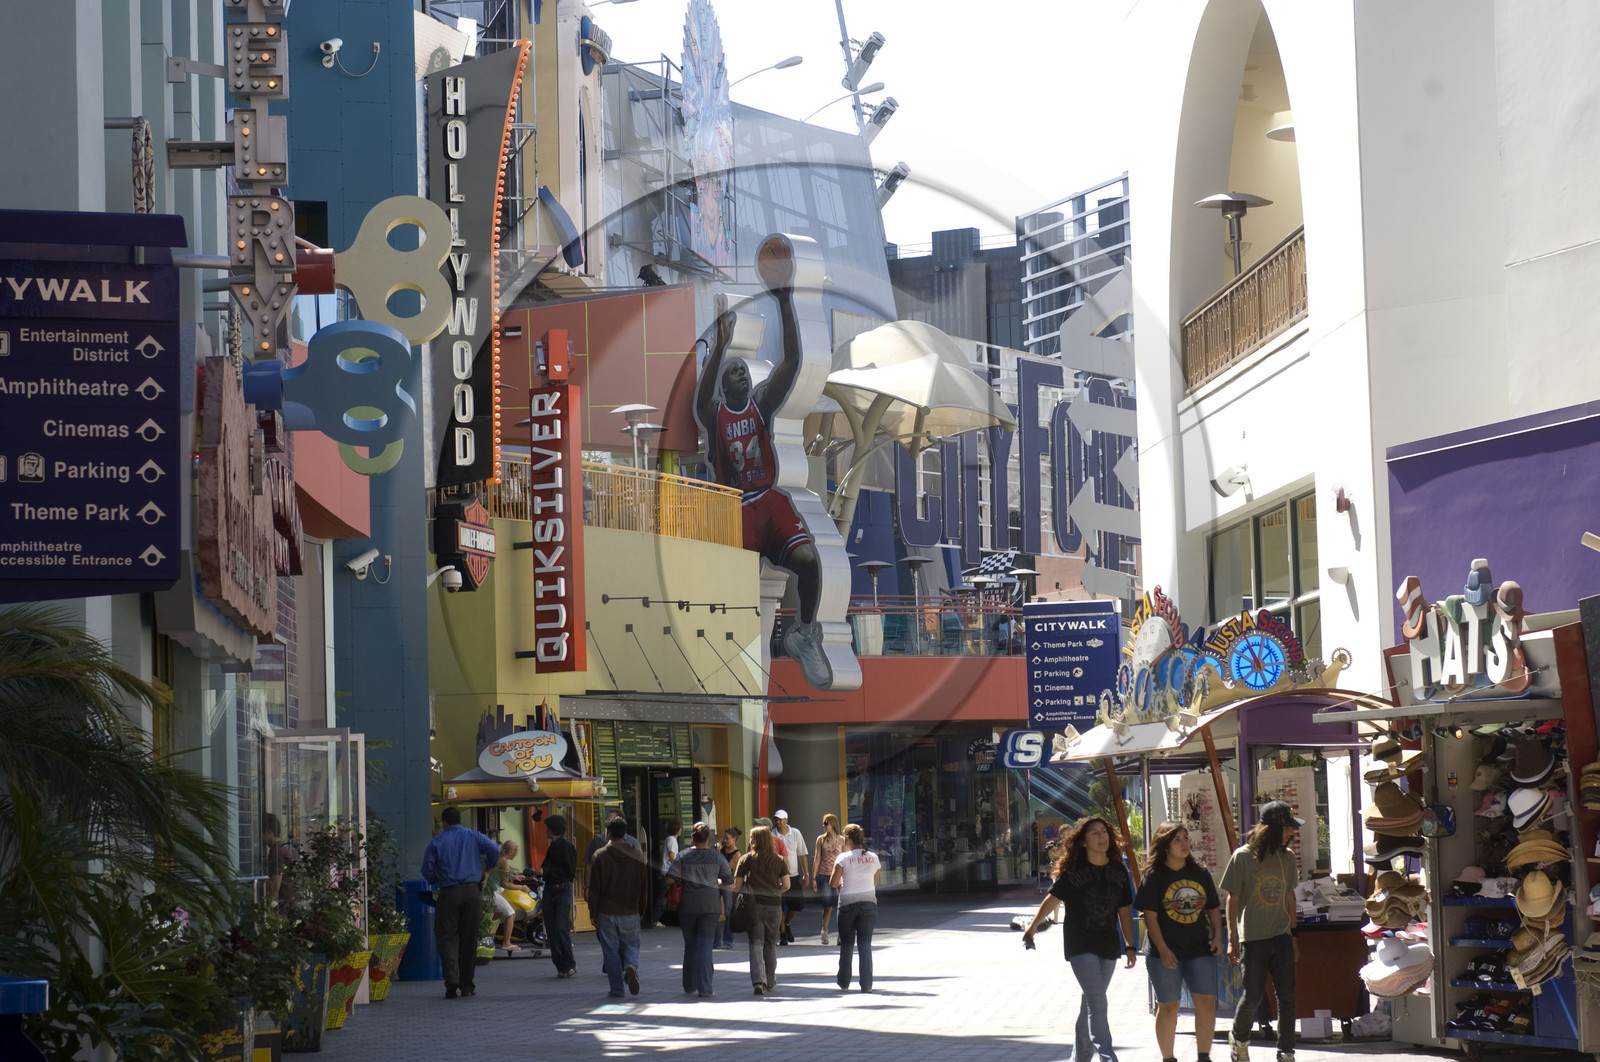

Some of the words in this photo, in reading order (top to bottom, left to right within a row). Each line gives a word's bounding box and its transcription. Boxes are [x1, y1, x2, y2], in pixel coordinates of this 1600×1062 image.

[226, 0, 297, 357] ELRY
[445, 77, 478, 466] HOLLYWOOD
[0, 277, 151, 303] YWALK
[20, 328, 129, 345] Entertainment
[73, 348, 129, 362] District
[43, 420, 129, 438] Cinemas
[733, 418, 757, 438] NBA
[730, 435, 763, 471] 34
[55, 461, 130, 483] Parking
[12, 503, 79, 521] Theme
[85, 504, 130, 521] Park
[531, 391, 569, 663] QUIKSILVER
[72, 555, 133, 566] Entrance
[1034, 620, 1107, 632] CITYWALK
[1153, 585, 1184, 649] SECOND
[1043, 641, 1066, 649] Theme
[1067, 640, 1083, 648] Park
[1204, 617, 1240, 657] JUST
[1242, 610, 1256, 632] A
[1258, 609, 1304, 662] SECOND
[1409, 600, 1517, 691] HATS
[1044, 655, 1089, 663] Amphitheatre
[1044, 670, 1070, 678] Parking
[1044, 684, 1074, 692] Cinemas
[1045, 698, 1071, 707] Parking
[489, 733, 557, 756] CARTOON
[514, 748, 534, 759] OF
[503, 754, 553, 774] YOU
